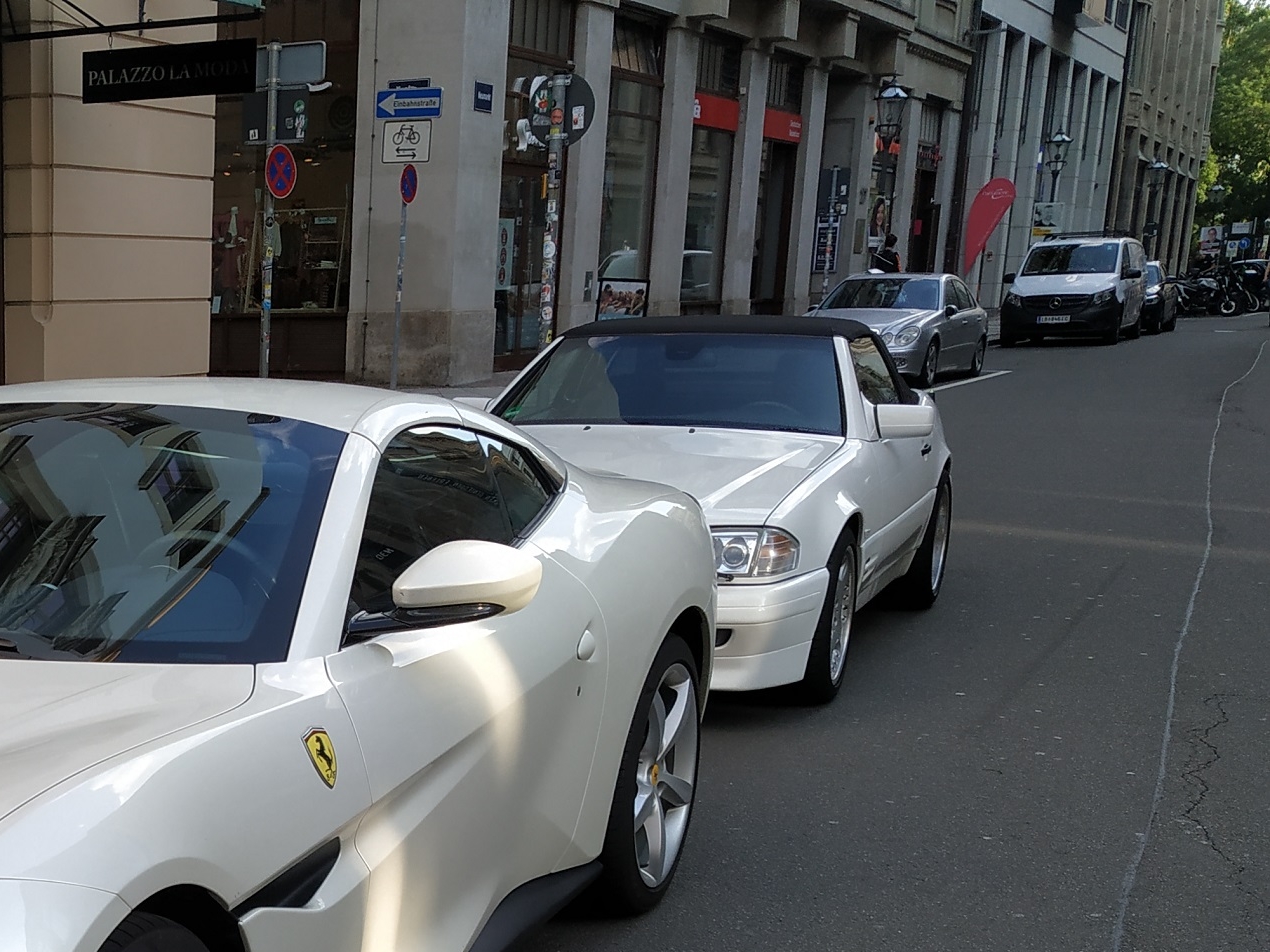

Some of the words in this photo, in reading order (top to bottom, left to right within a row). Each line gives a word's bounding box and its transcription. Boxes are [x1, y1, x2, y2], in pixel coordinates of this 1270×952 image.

[88, 65, 165, 87] PALAZZO
[169, 64, 191, 80] LA
[194, 59, 249, 78] MODA
[393, 98, 437, 108] Einbahnstraße
